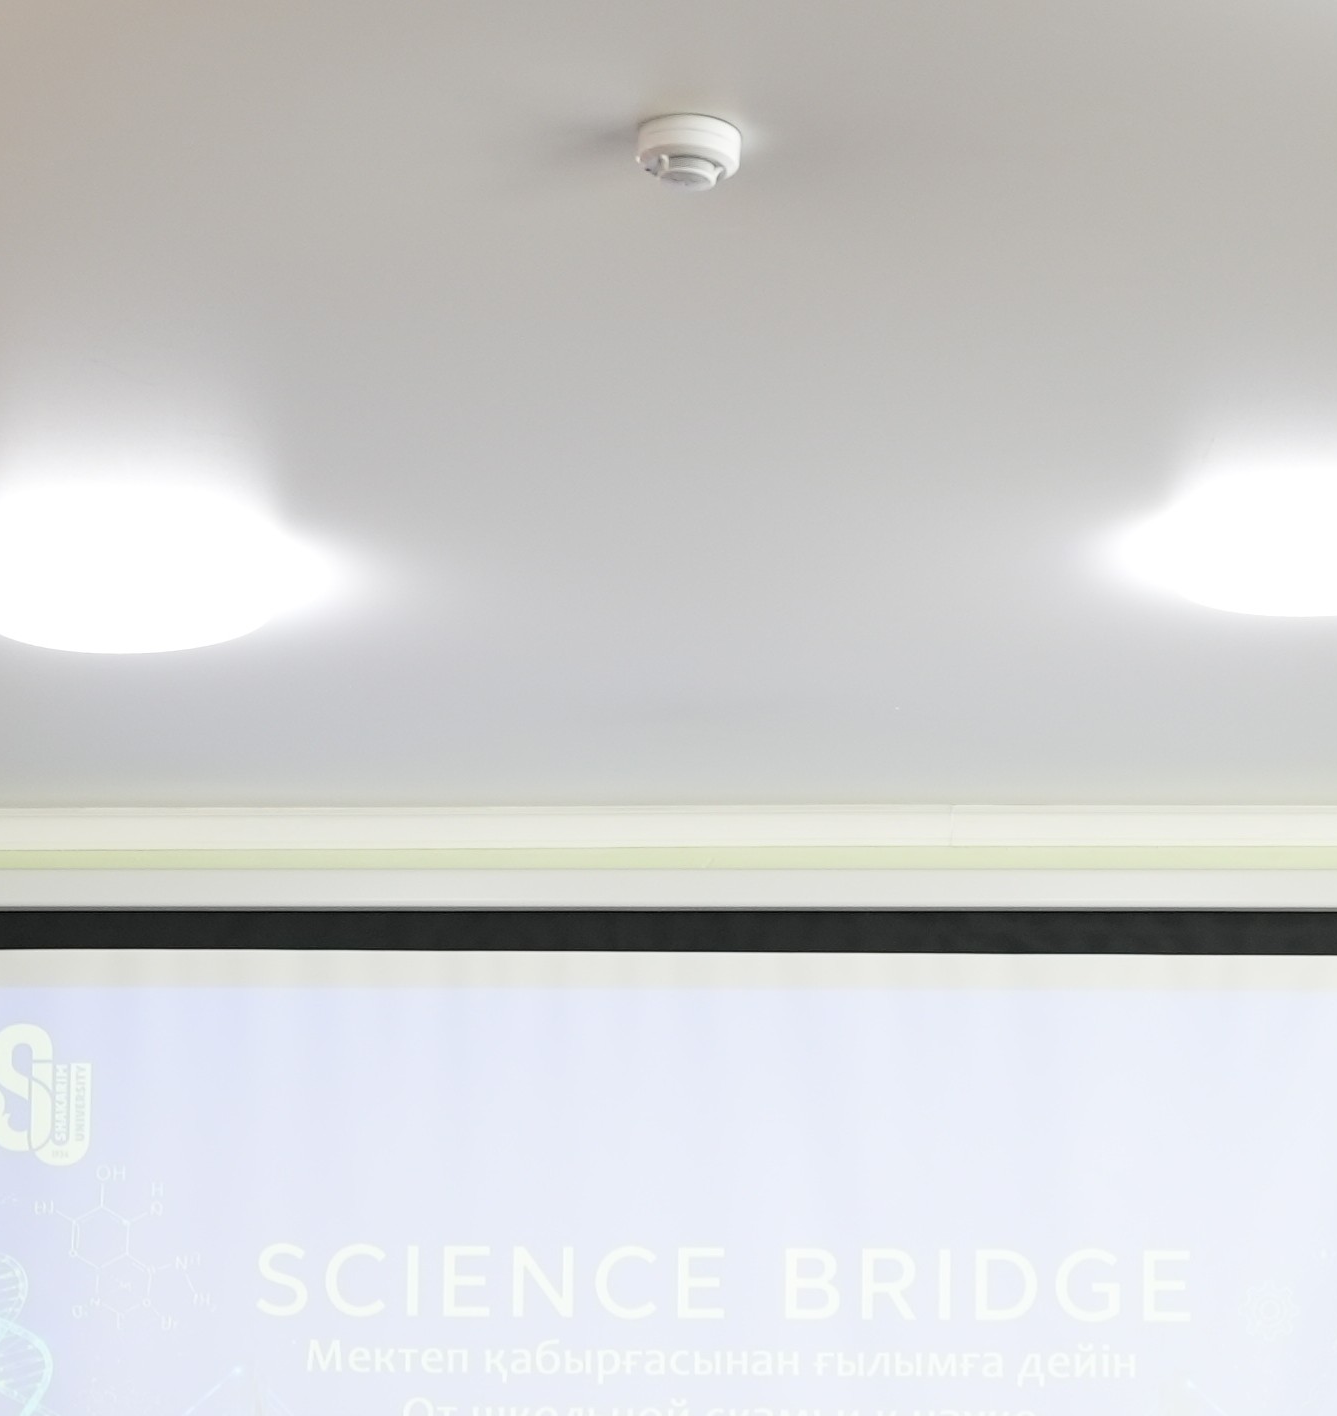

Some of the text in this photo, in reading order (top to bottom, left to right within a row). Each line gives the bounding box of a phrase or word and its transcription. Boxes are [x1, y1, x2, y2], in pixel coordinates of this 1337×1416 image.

[54, 1064, 68, 1143] SHAKARIM
[74, 1064, 87, 1142] UNIVERSITY
[256, 1242, 1193, 1324] SCIENCE BRIDGE
[306, 1339, 1137, 1387] Мектеп қабырғасынан ғылымға дейін
